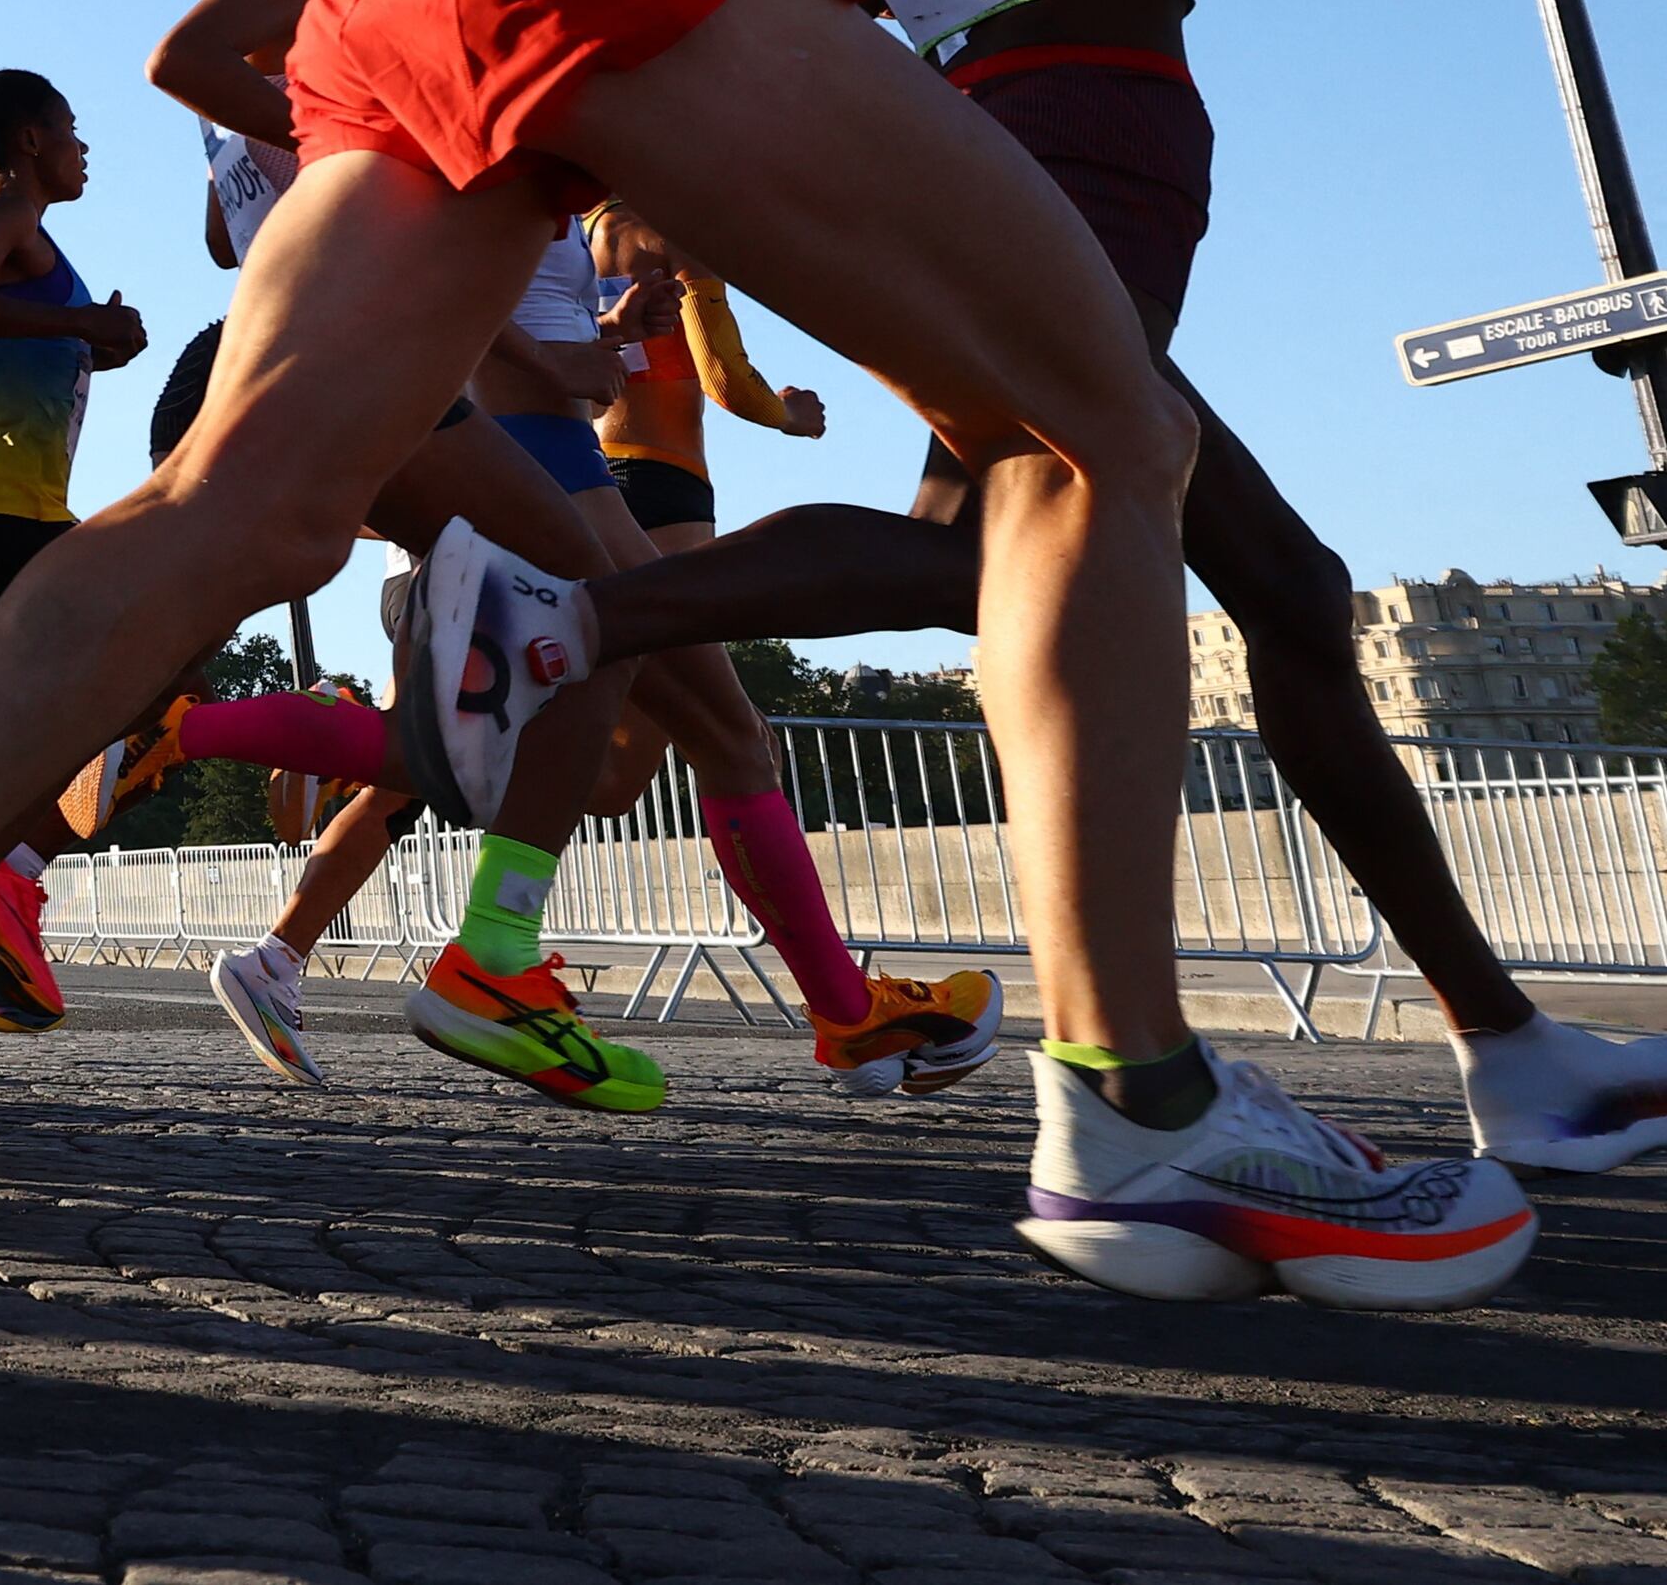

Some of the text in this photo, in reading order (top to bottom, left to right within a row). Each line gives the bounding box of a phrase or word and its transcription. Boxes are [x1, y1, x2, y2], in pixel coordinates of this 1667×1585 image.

[1484, 292, 1634, 342] ESCALE-BATOBUS
[1515, 319, 1612, 353] TOUR EIFFEL
